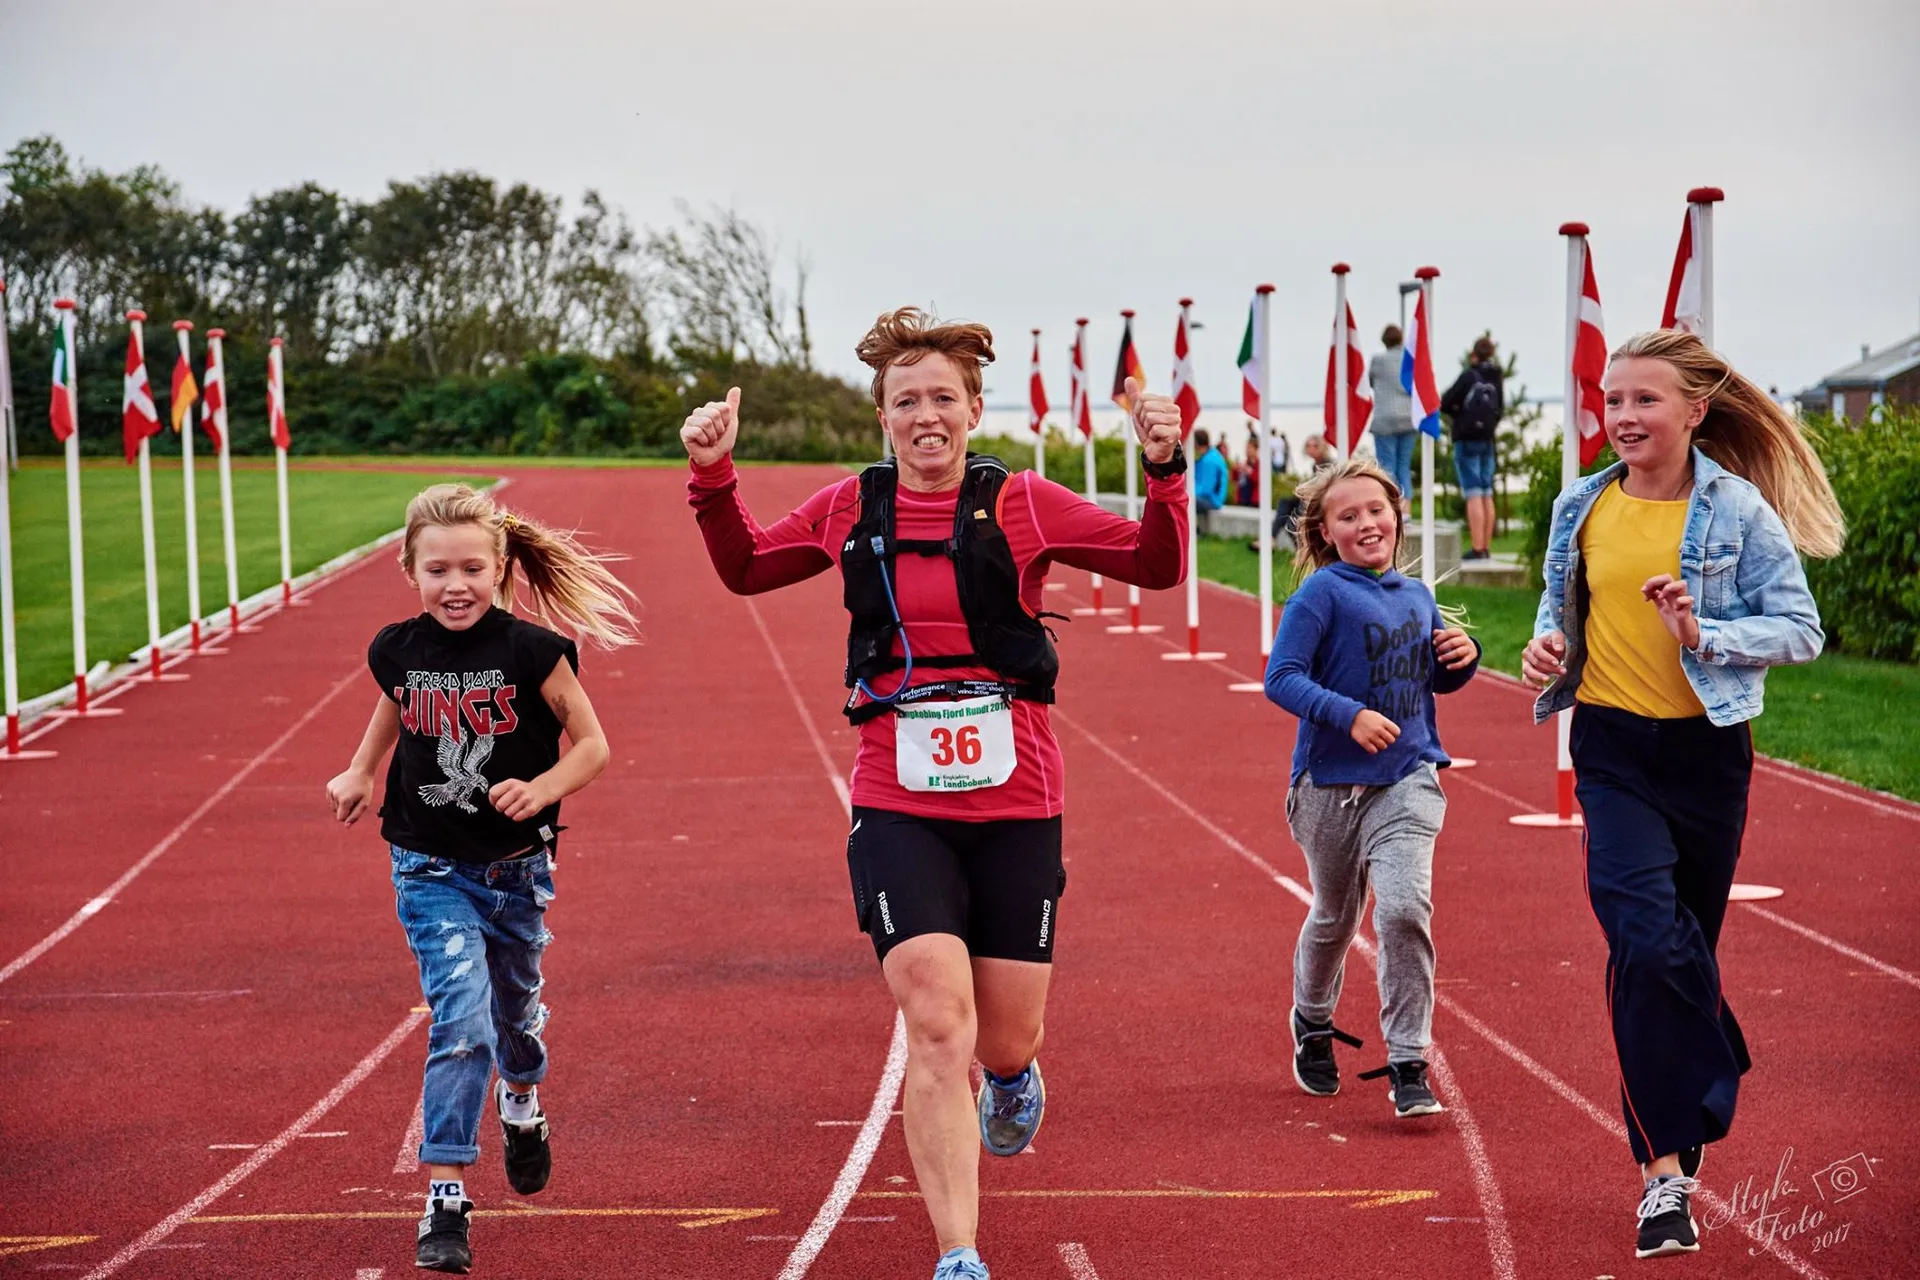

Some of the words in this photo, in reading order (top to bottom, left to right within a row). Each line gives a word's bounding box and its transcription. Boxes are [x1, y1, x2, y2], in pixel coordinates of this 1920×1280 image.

[406, 671, 460, 690] SPREAD
[463, 670, 505, 692] YOUR
[900, 684, 946, 700] performance
[394, 685, 519, 747] WINGS
[943, 707, 965, 719] Fjord
[966, 704, 989, 716] Rundt
[930, 725, 982, 766] 36
[943, 776, 992, 788] Landbobank
[432, 1183, 460, 1197] YC
